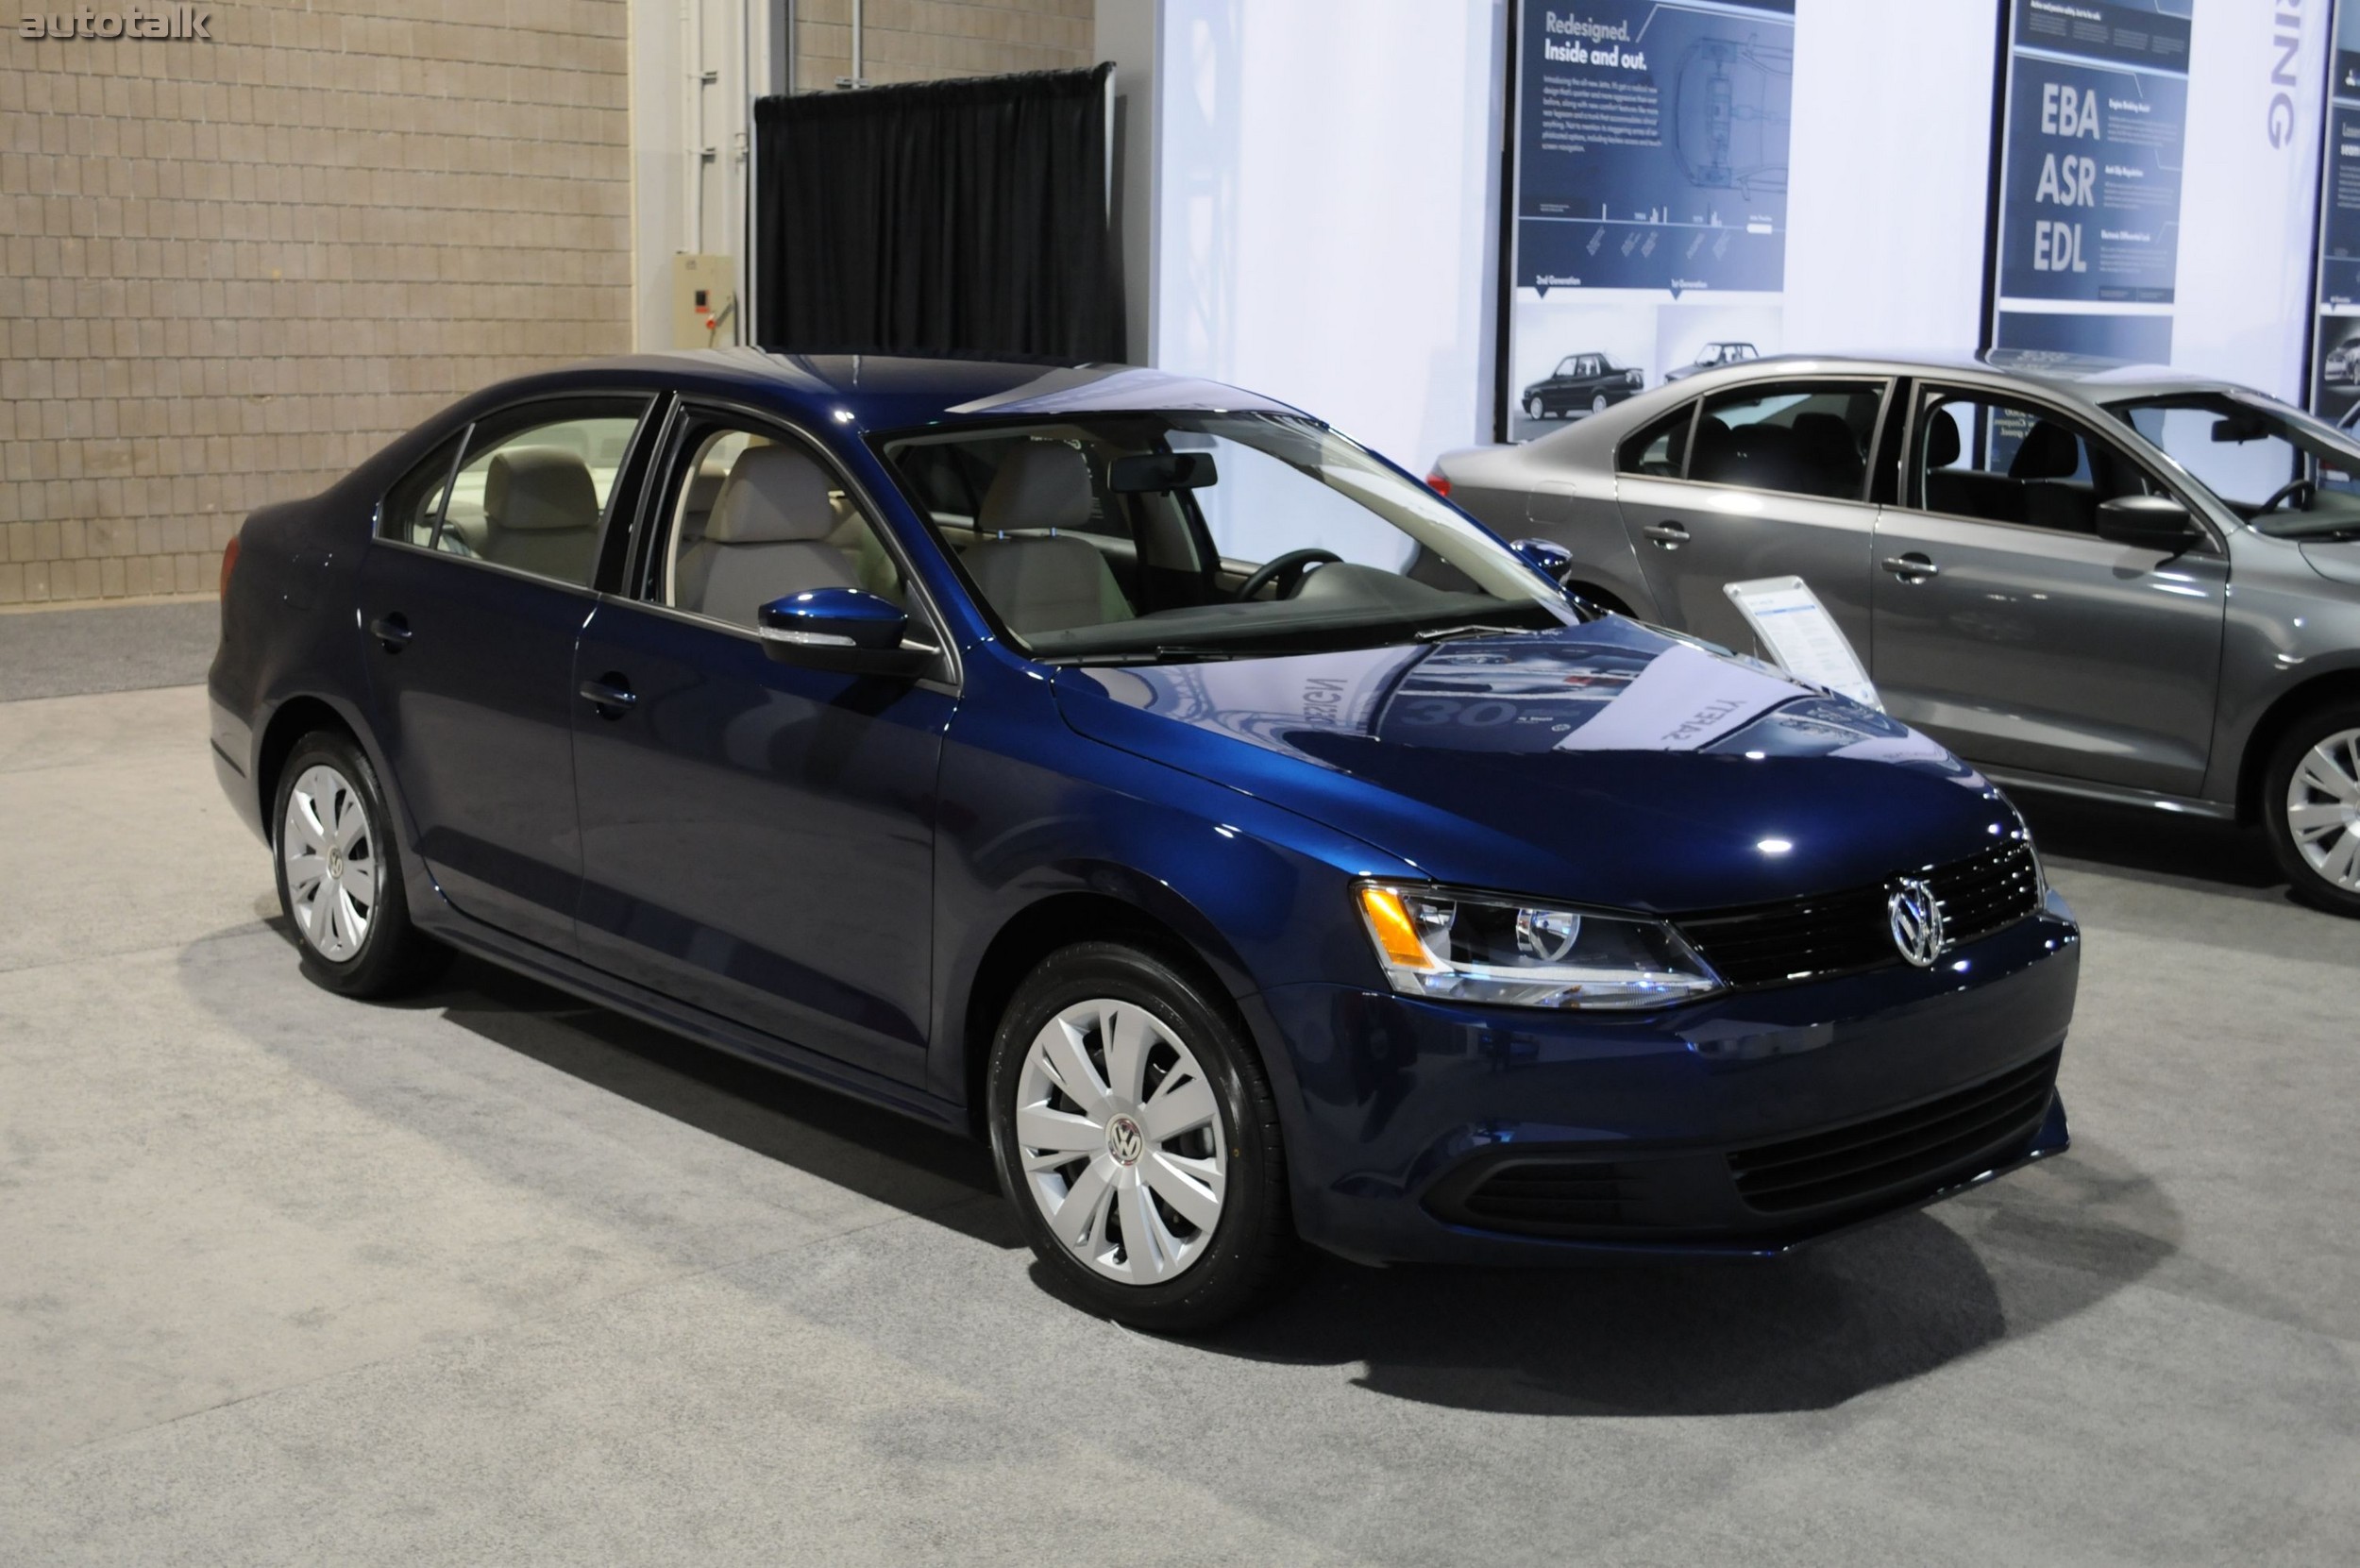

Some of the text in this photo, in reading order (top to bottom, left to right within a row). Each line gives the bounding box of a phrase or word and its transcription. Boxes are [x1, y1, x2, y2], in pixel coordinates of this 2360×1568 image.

[1546, 11, 1630, 43] Redesigned.
[1544, 38, 1647, 71] Inside and out.
[2267, 0, 2301, 150] ING
[2041, 82, 2100, 140] EBA
[2035, 153, 2096, 207] ASR
[2033, 220, 2086, 273] EDL
